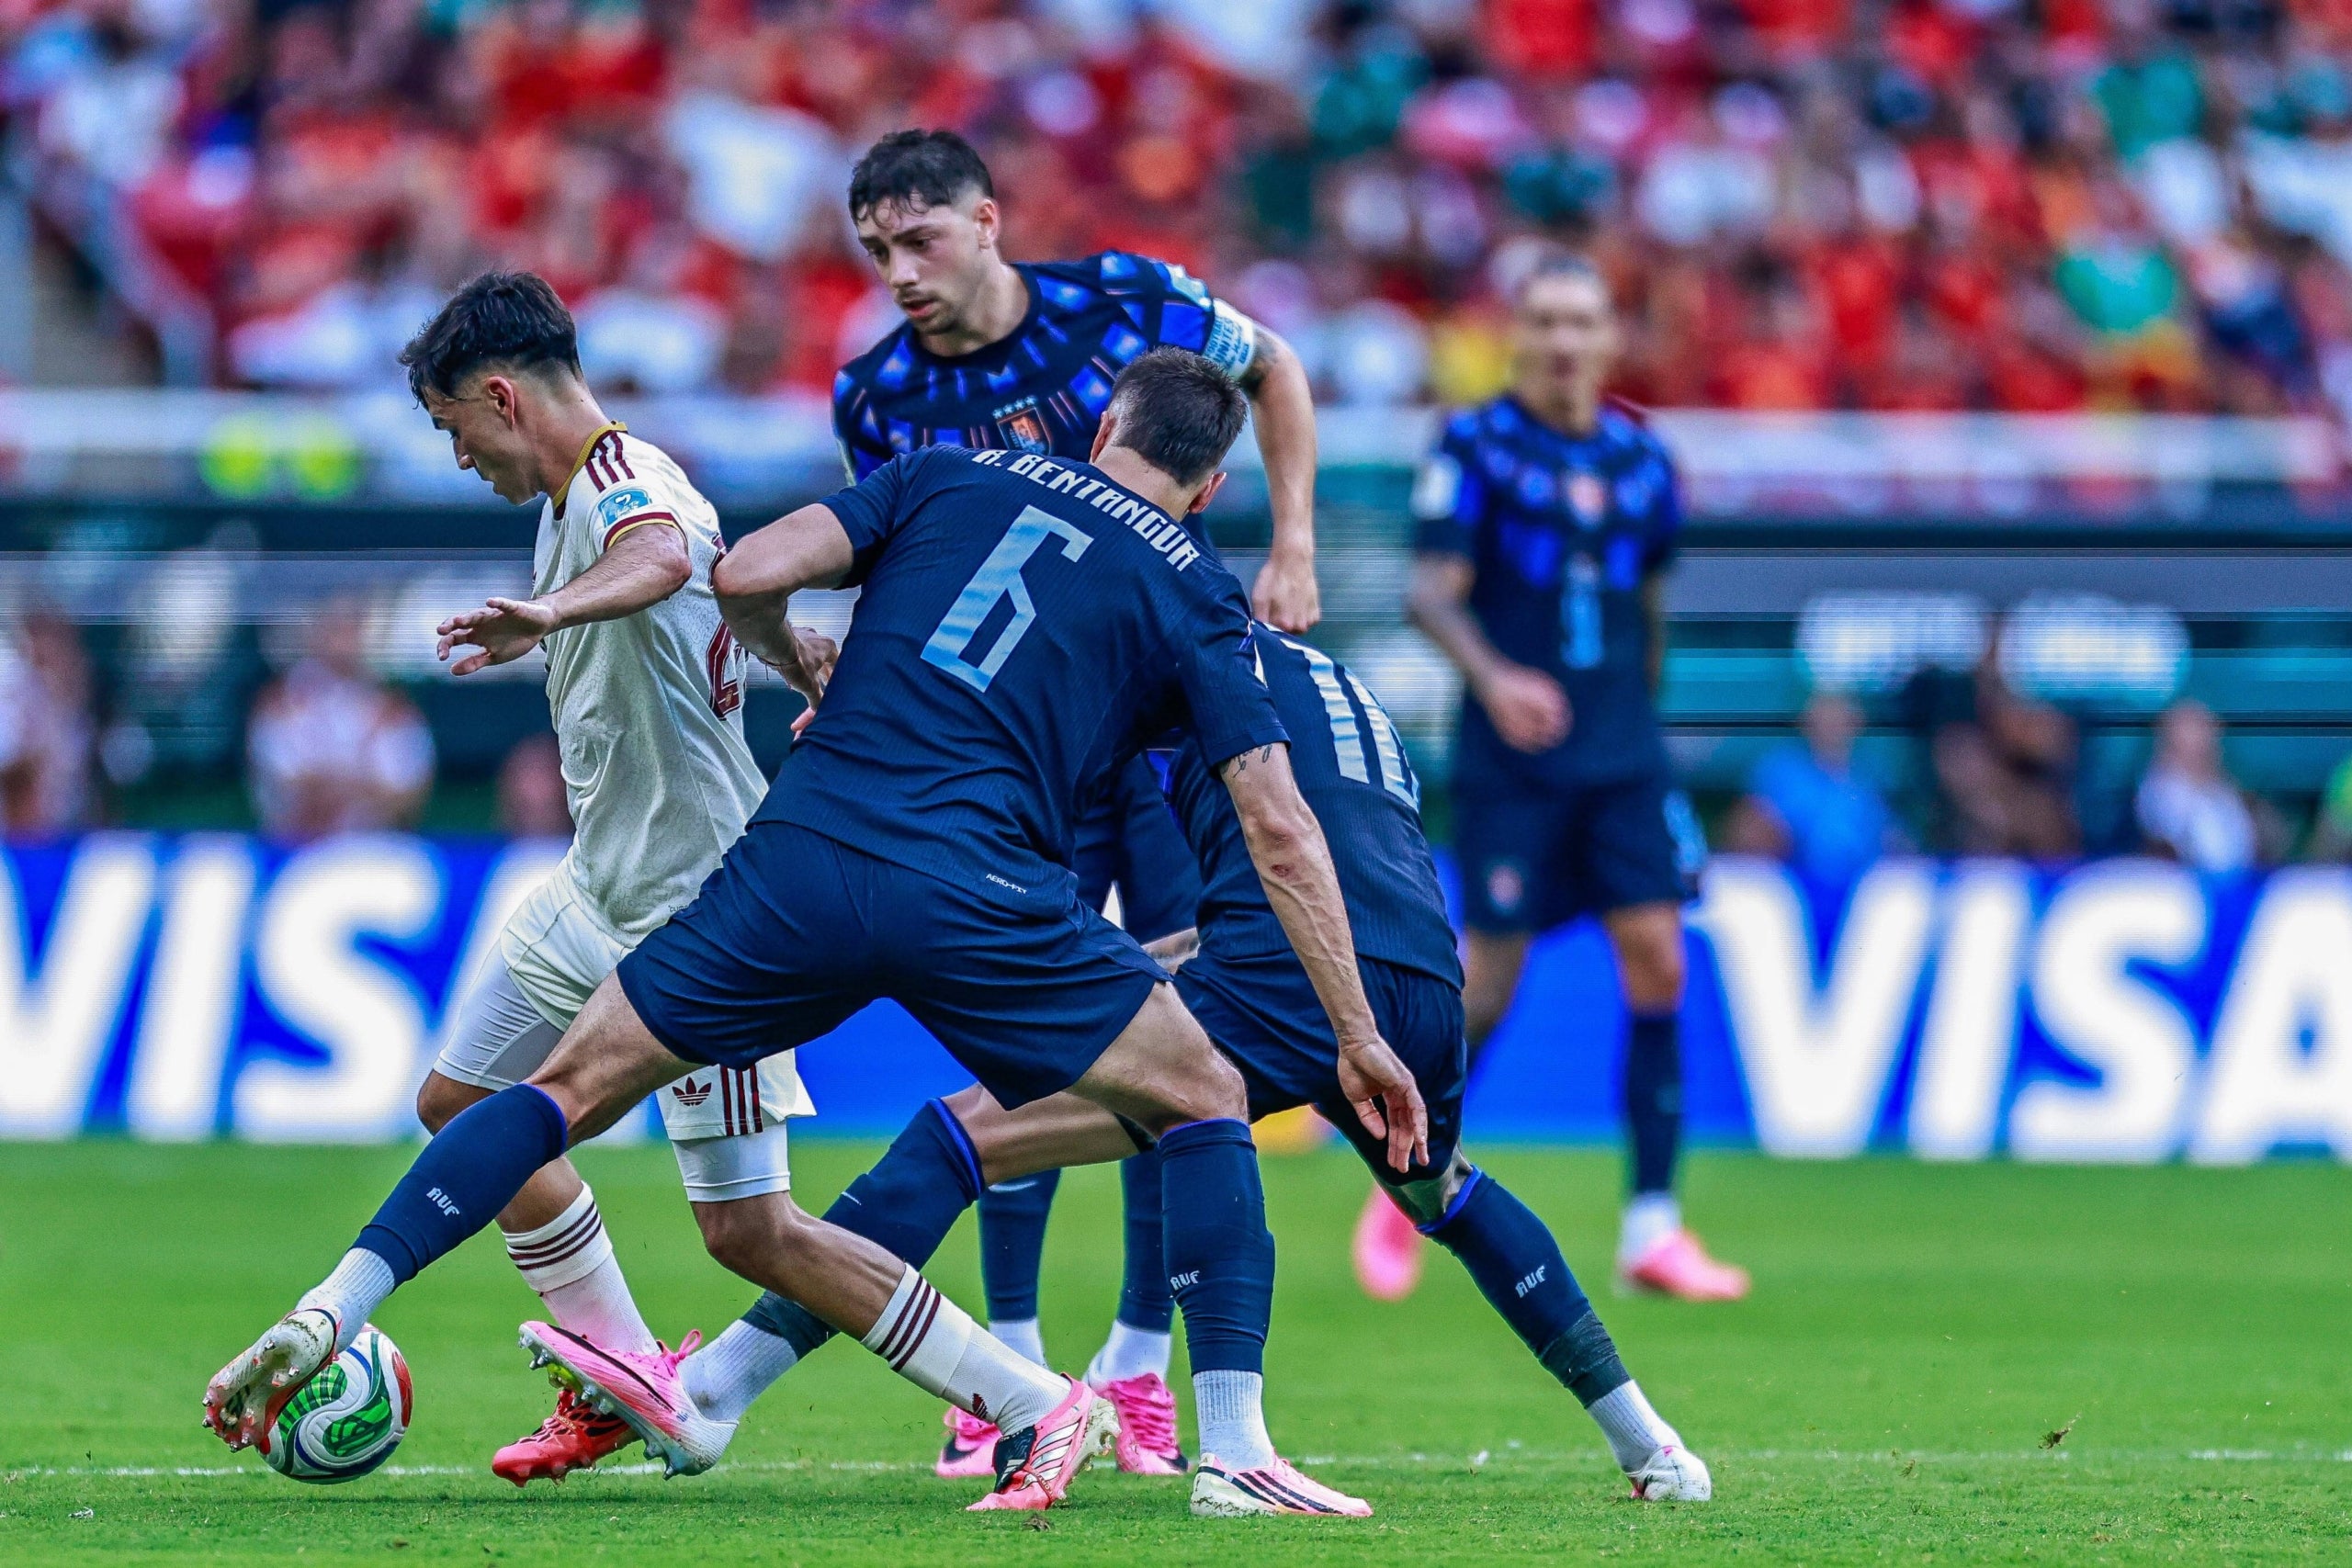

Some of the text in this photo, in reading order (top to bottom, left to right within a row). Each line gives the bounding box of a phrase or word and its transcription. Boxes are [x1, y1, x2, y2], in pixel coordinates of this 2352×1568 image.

[1007, 454, 1201, 571] BENTANCUR
[921, 504, 1094, 694] 6
[1279, 637, 1419, 814] 10
[1700, 854, 2352, 1163] VISA
[425, 1186, 460, 1216] AUF
[1170, 1269, 1200, 1291] AUF
[1515, 1265, 1545, 1298] AUF
